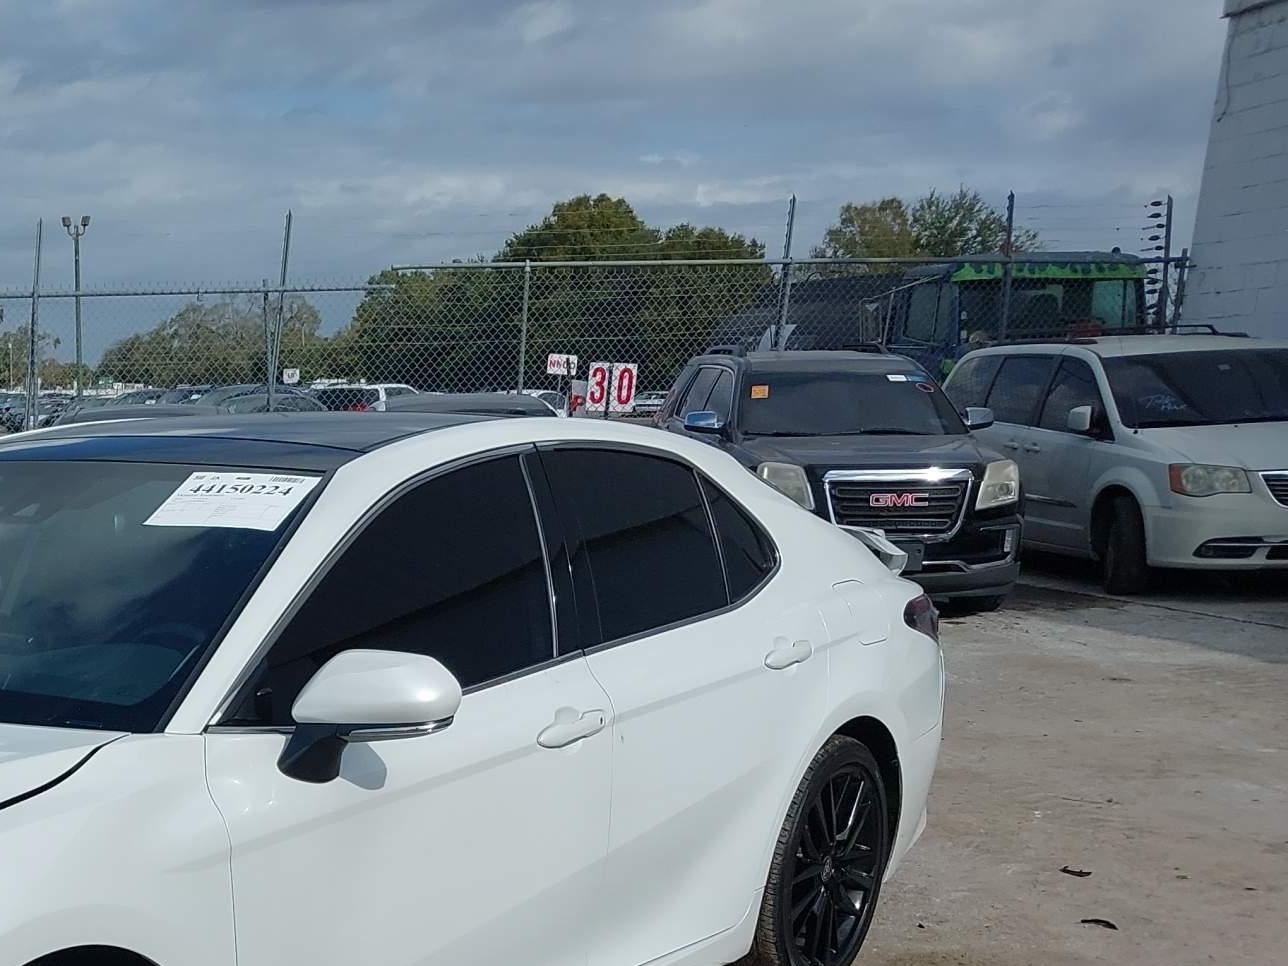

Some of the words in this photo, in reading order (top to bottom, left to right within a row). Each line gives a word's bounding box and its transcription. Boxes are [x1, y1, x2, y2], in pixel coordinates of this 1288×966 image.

[589, 366, 634, 405] 30
[189, 483, 294, 497] 44150224
[870, 493, 929, 507] GMC
